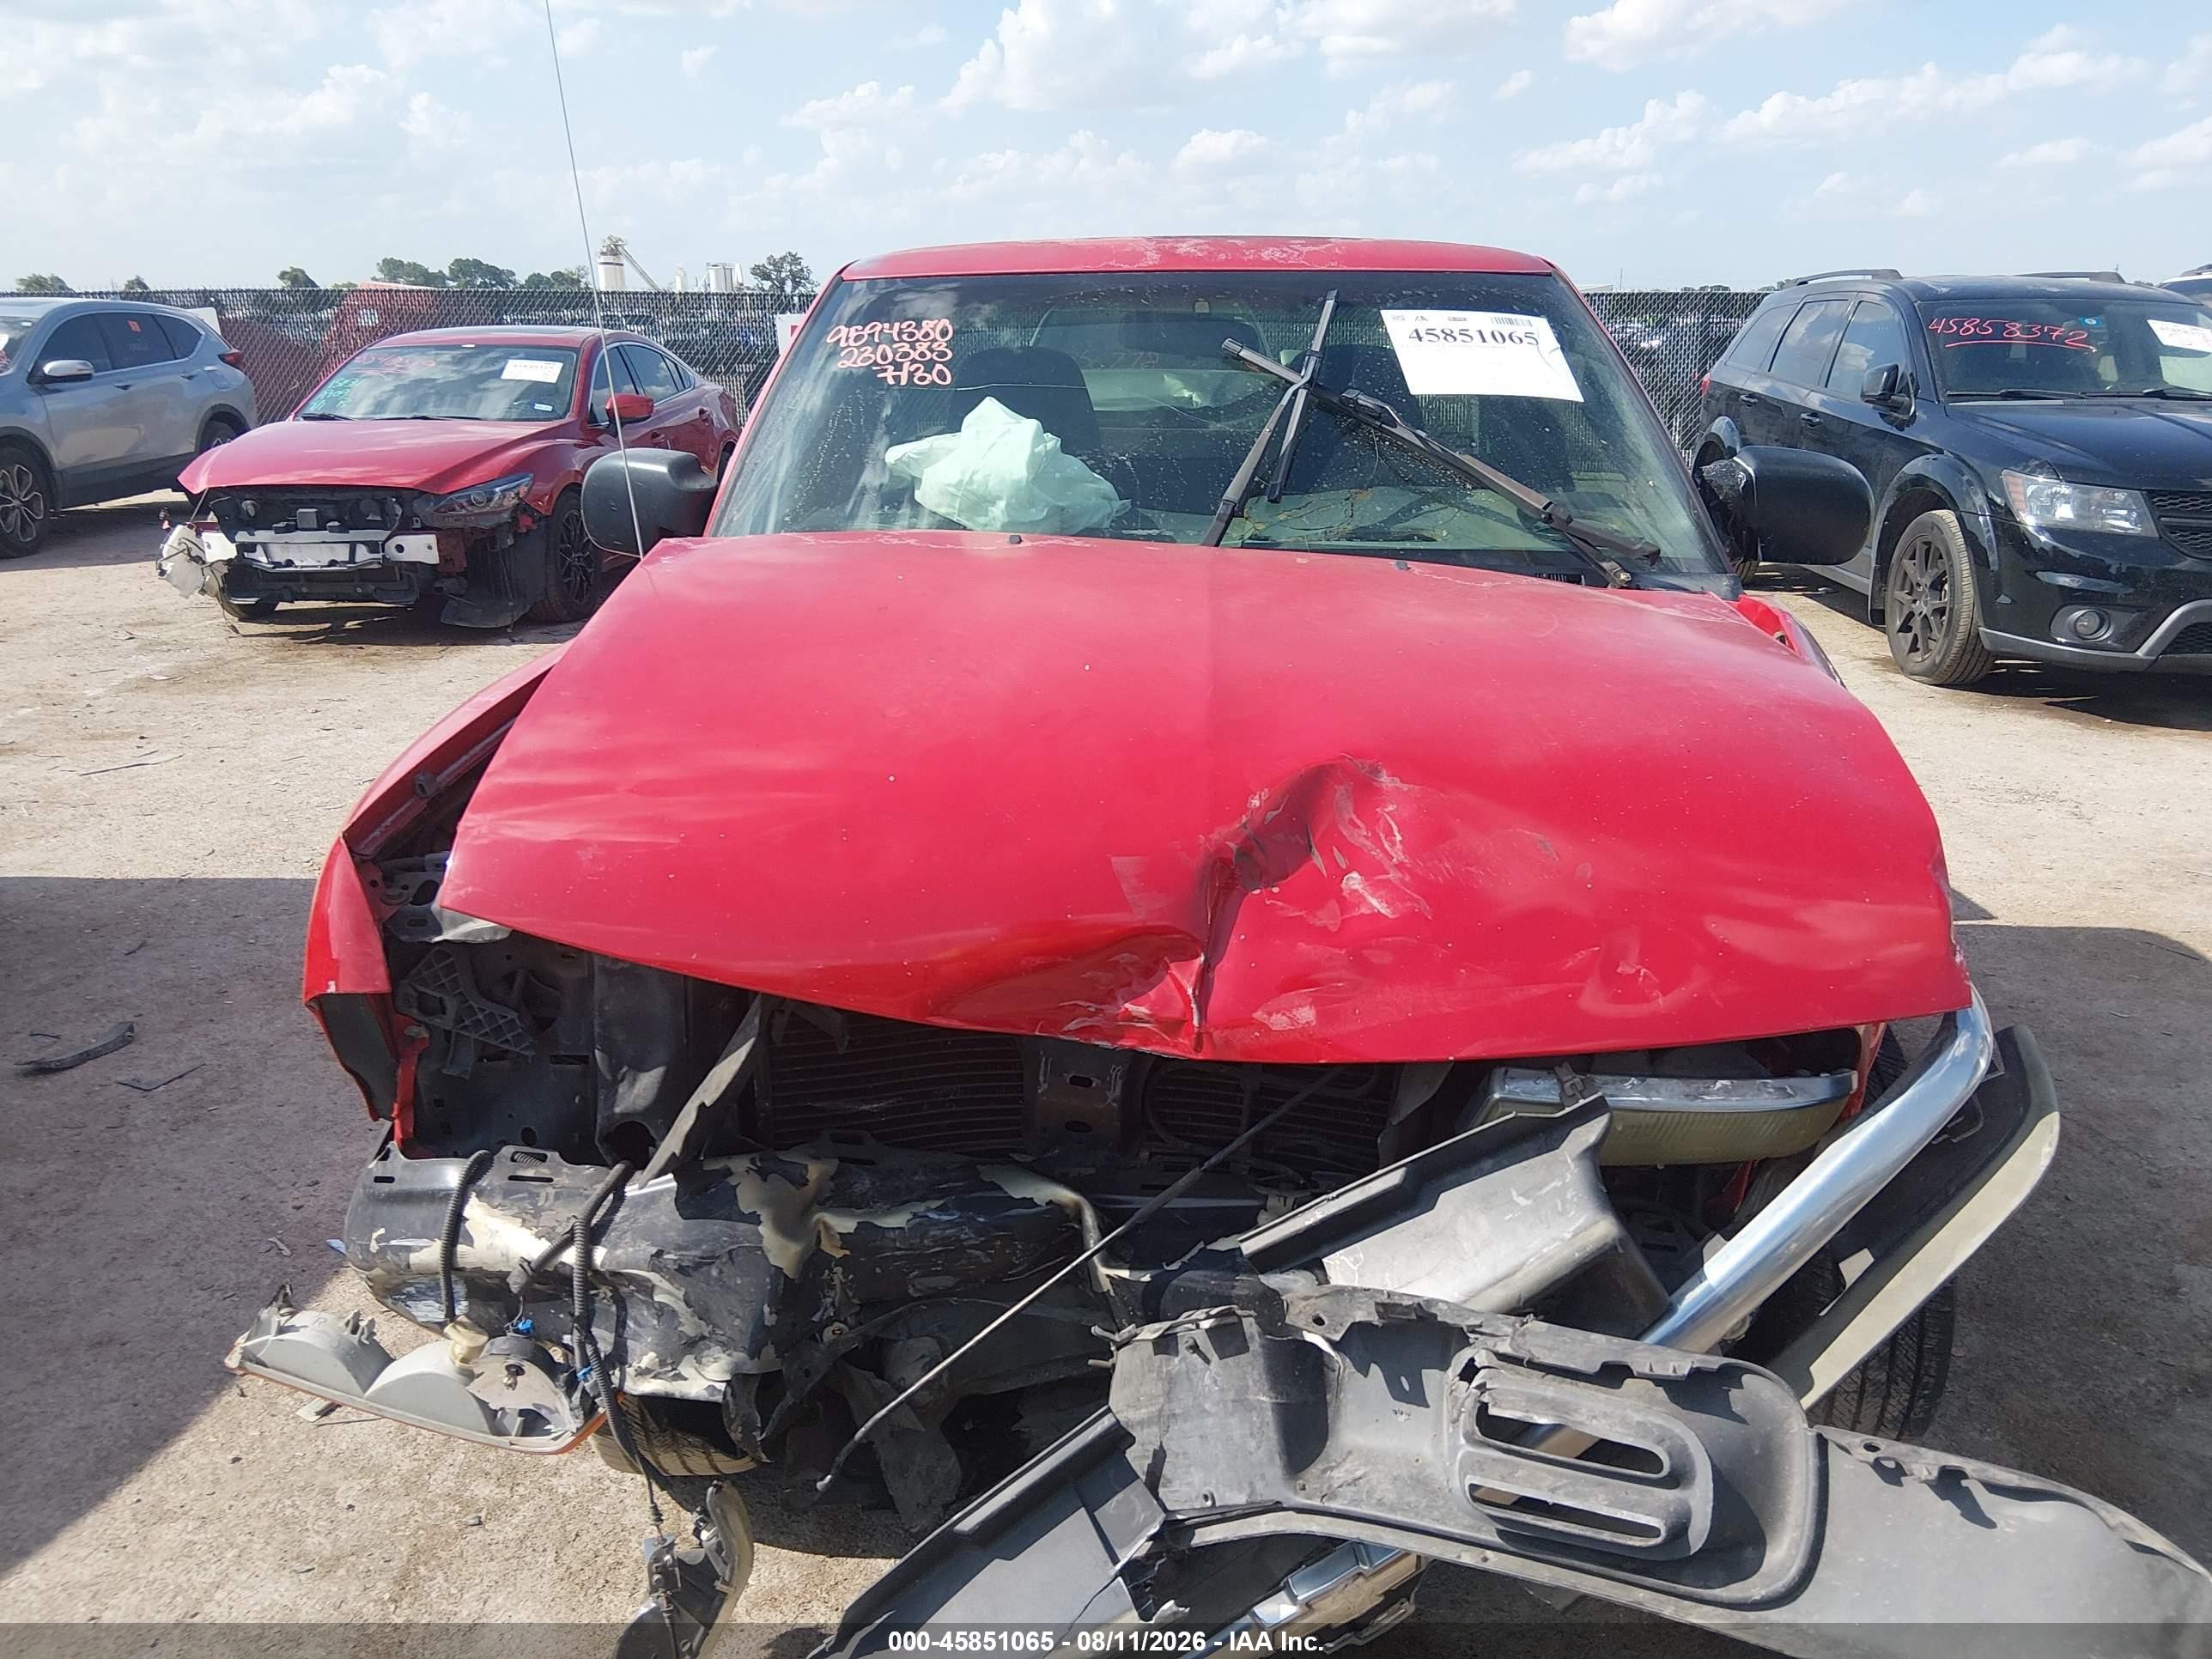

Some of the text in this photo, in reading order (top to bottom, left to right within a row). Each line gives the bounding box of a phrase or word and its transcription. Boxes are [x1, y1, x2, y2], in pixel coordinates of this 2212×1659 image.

[1408, 328, 1540, 346] 45851065
[1929, 317, 2094, 349] 45858372
[837, 342, 953, 368] 230383
